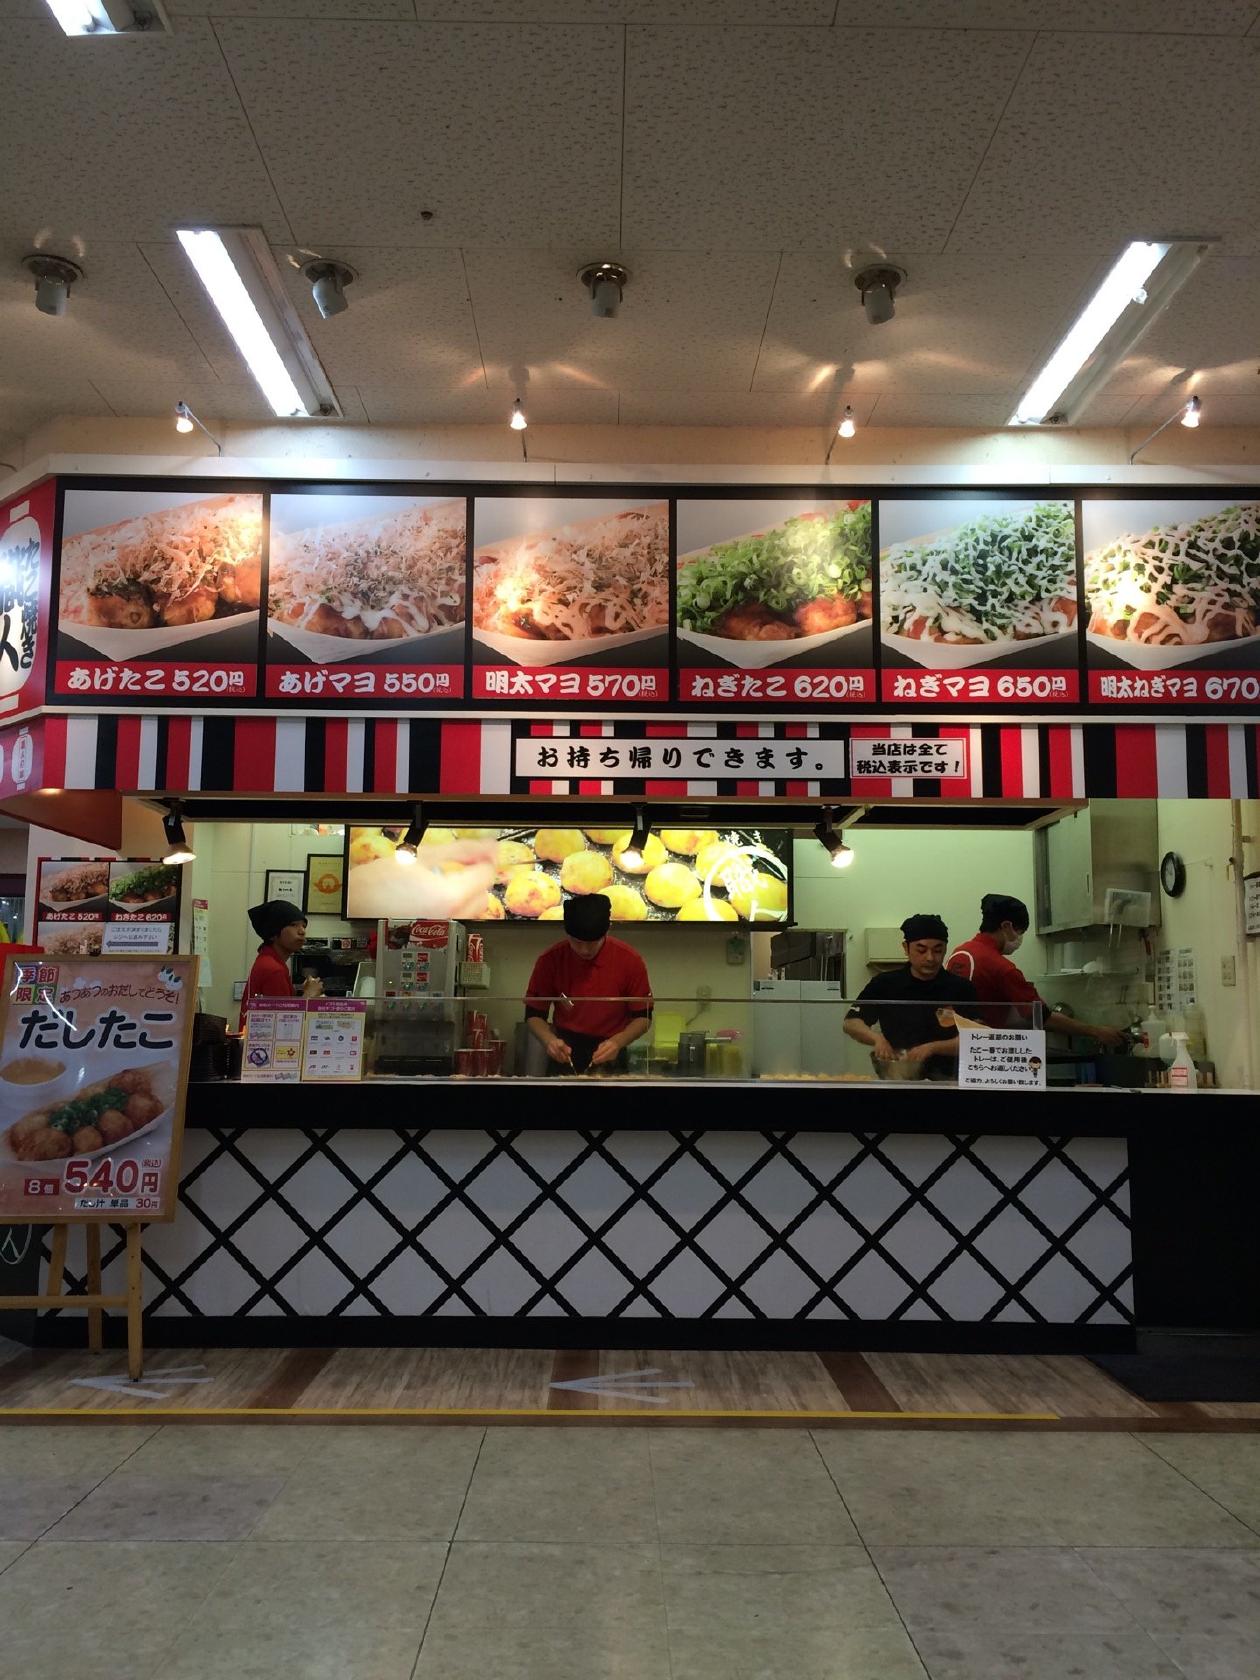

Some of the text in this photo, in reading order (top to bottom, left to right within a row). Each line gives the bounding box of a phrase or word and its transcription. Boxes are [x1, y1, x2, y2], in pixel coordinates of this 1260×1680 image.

[67, 667, 166, 691] あげたこ
[172, 670, 245, 692] 520円
[278, 669, 376, 693] あげマヨ
[383, 673, 450, 693] 550円
[485, 670, 581, 694] 明太マヨ
[587, 674, 656, 697] 570円
[691, 673, 787, 697] ねぎたこ
[794, 675, 865, 698] 620円
[893, 673, 990, 697] ねぎマヨ
[997, 675, 1067, 698] 650円
[1100, 675, 1260, 700] 明太ねぎマヨ 670
[536, 745, 824, 770] お持ち帰りできます。
[872, 743, 948, 756] 当店は全て
[857, 760, 960, 774] 税込表示です！
[19, 1009, 174, 1050] だしたこ
[63, 1158, 160, 1195] 540円
